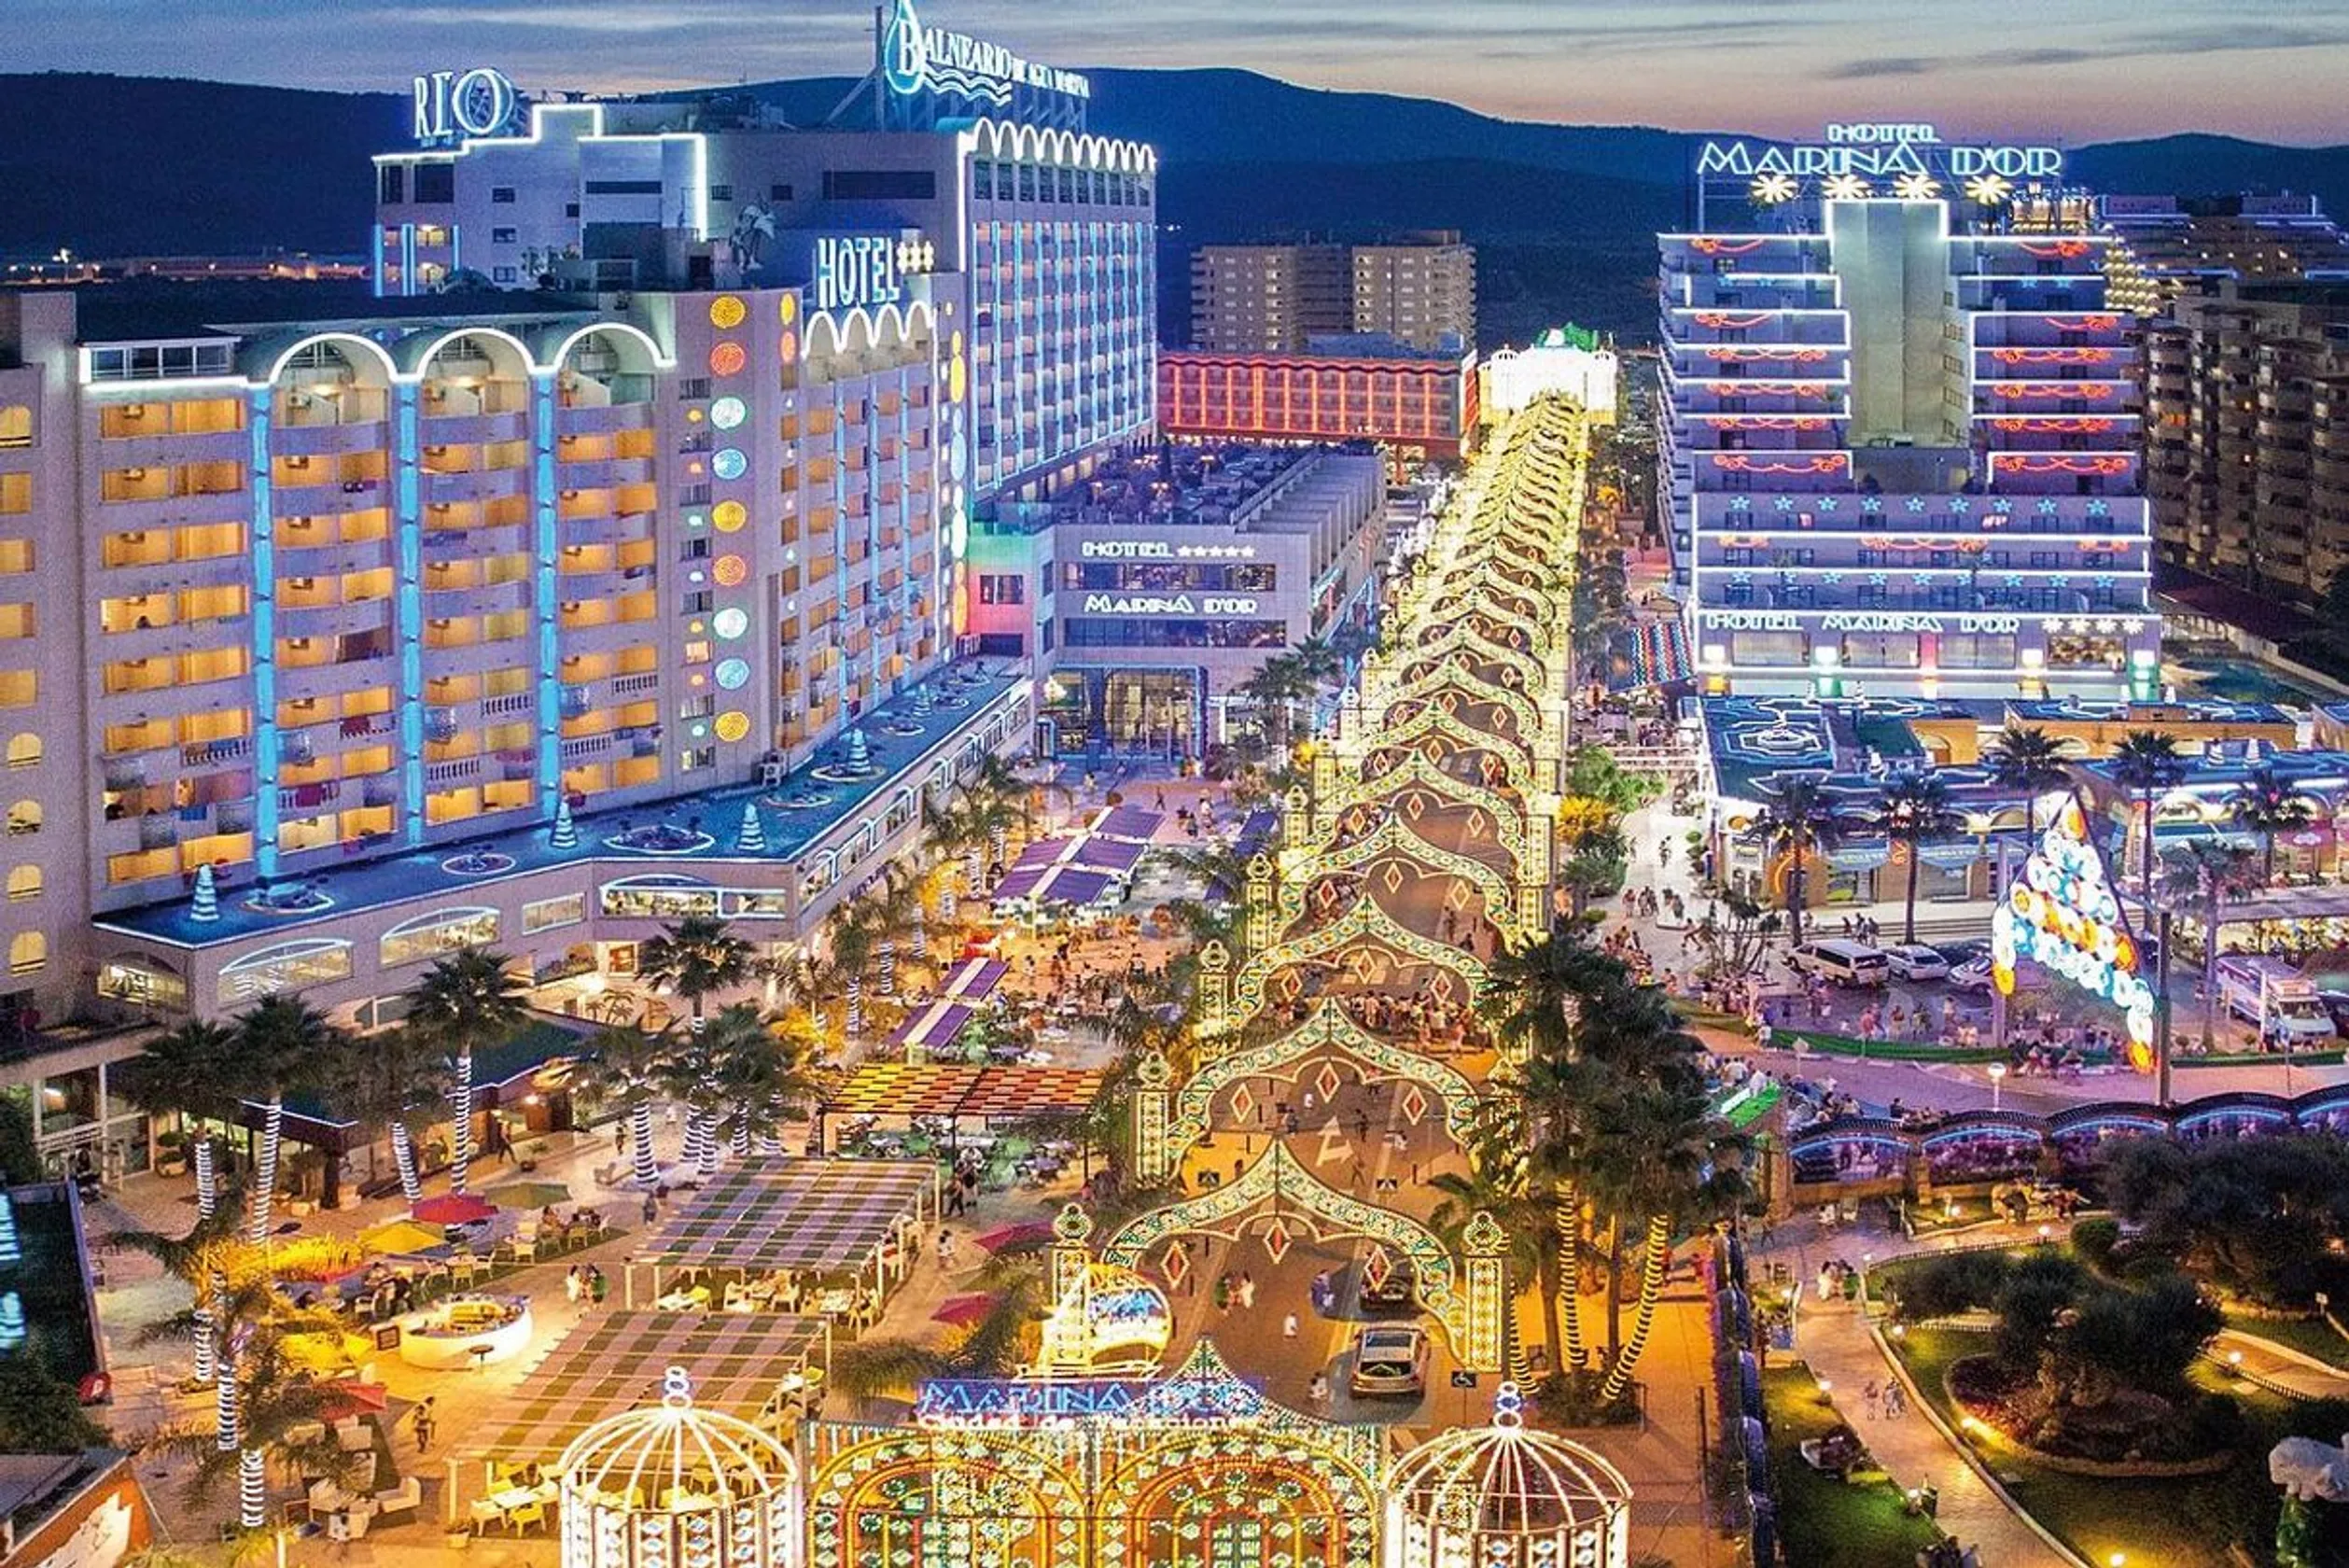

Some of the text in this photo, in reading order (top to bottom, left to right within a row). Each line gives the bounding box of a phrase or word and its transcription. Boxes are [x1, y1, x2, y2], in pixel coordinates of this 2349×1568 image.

[898, 19, 1011, 79] BALNEARIO
[413, 68, 513, 138] RIO
[1827, 124, 1939, 143] HOTEL
[1697, 141, 2062, 177] MARINA D'OR
[818, 237, 900, 308] HOTEL
[1082, 542, 1175, 558] HOTEL
[1084, 595, 1257, 614] MARINA D'OR
[1707, 614, 1802, 630] HOTEL
[1822, 615, 1941, 631] MARINA
[919, 1382, 1129, 1413] MARINA
